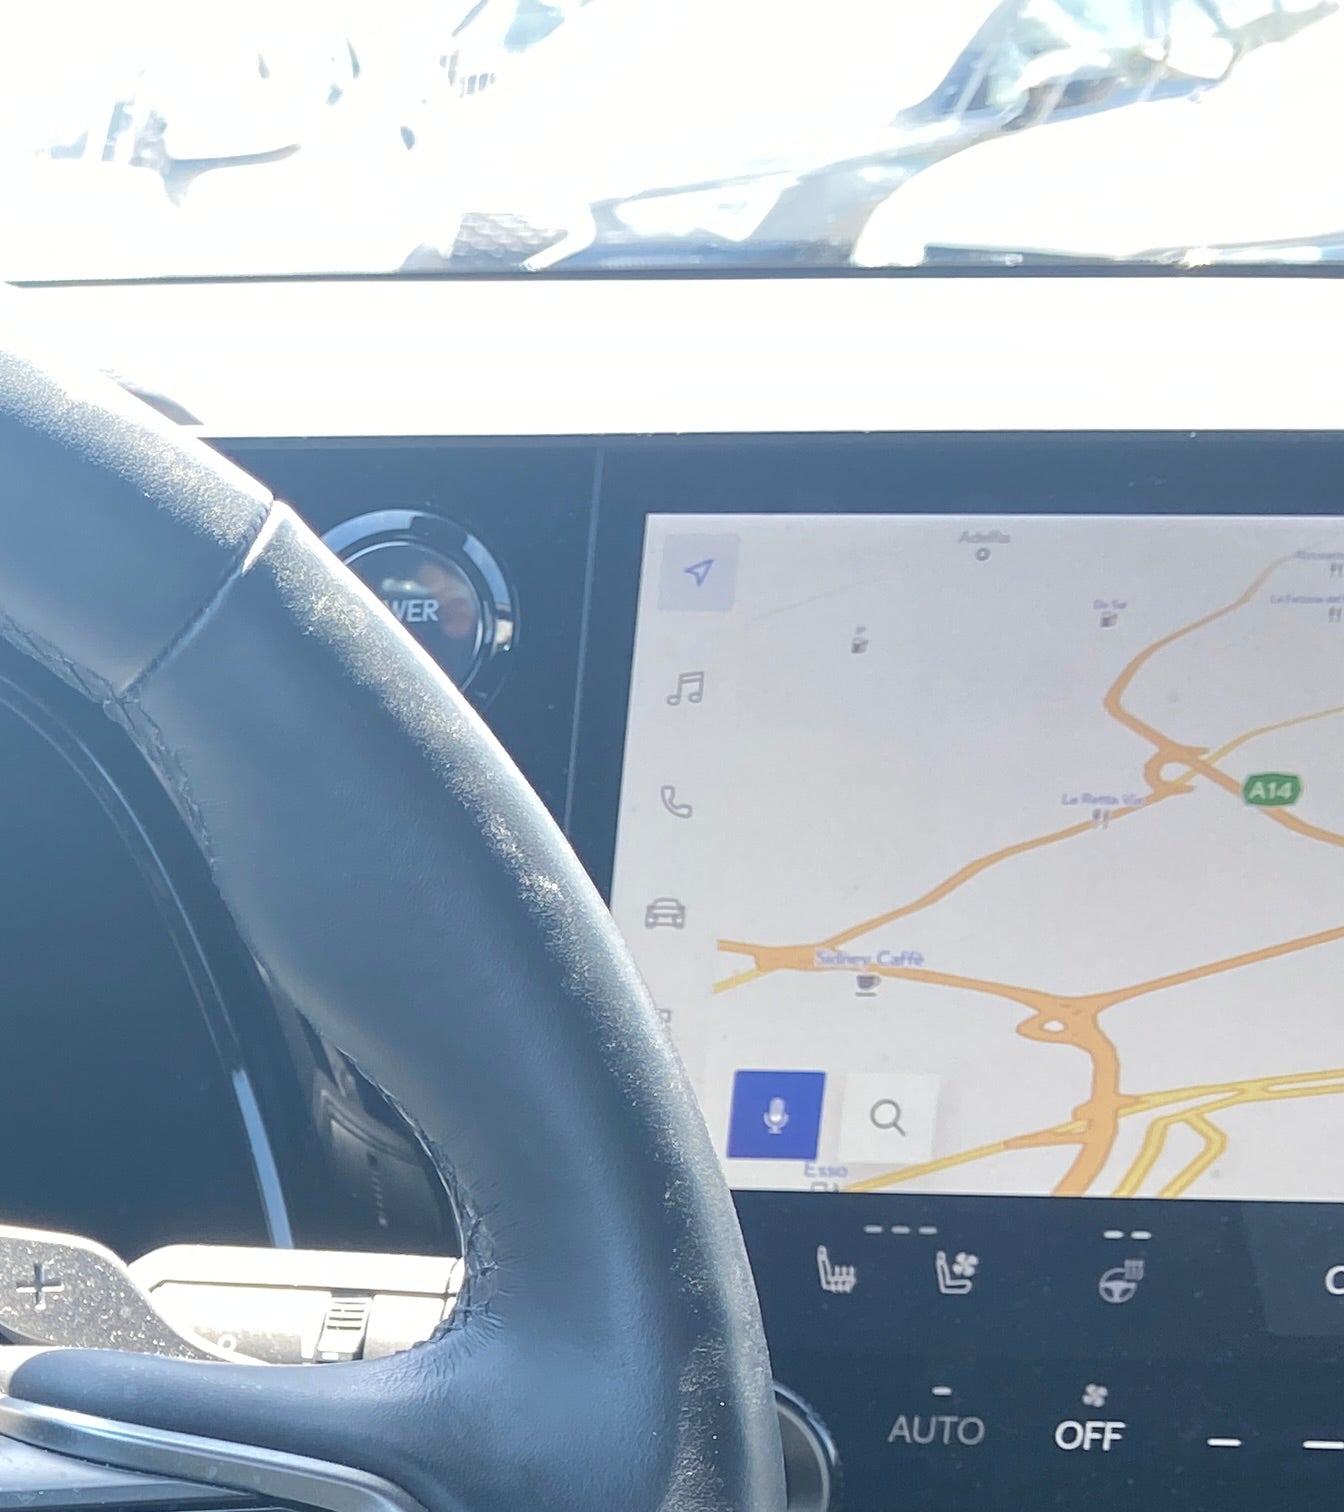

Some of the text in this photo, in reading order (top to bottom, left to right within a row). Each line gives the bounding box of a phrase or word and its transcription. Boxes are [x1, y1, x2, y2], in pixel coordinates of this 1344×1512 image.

[1249, 782, 1293, 800] A14
[887, 1414, 1127, 1451] AUTO OFF
